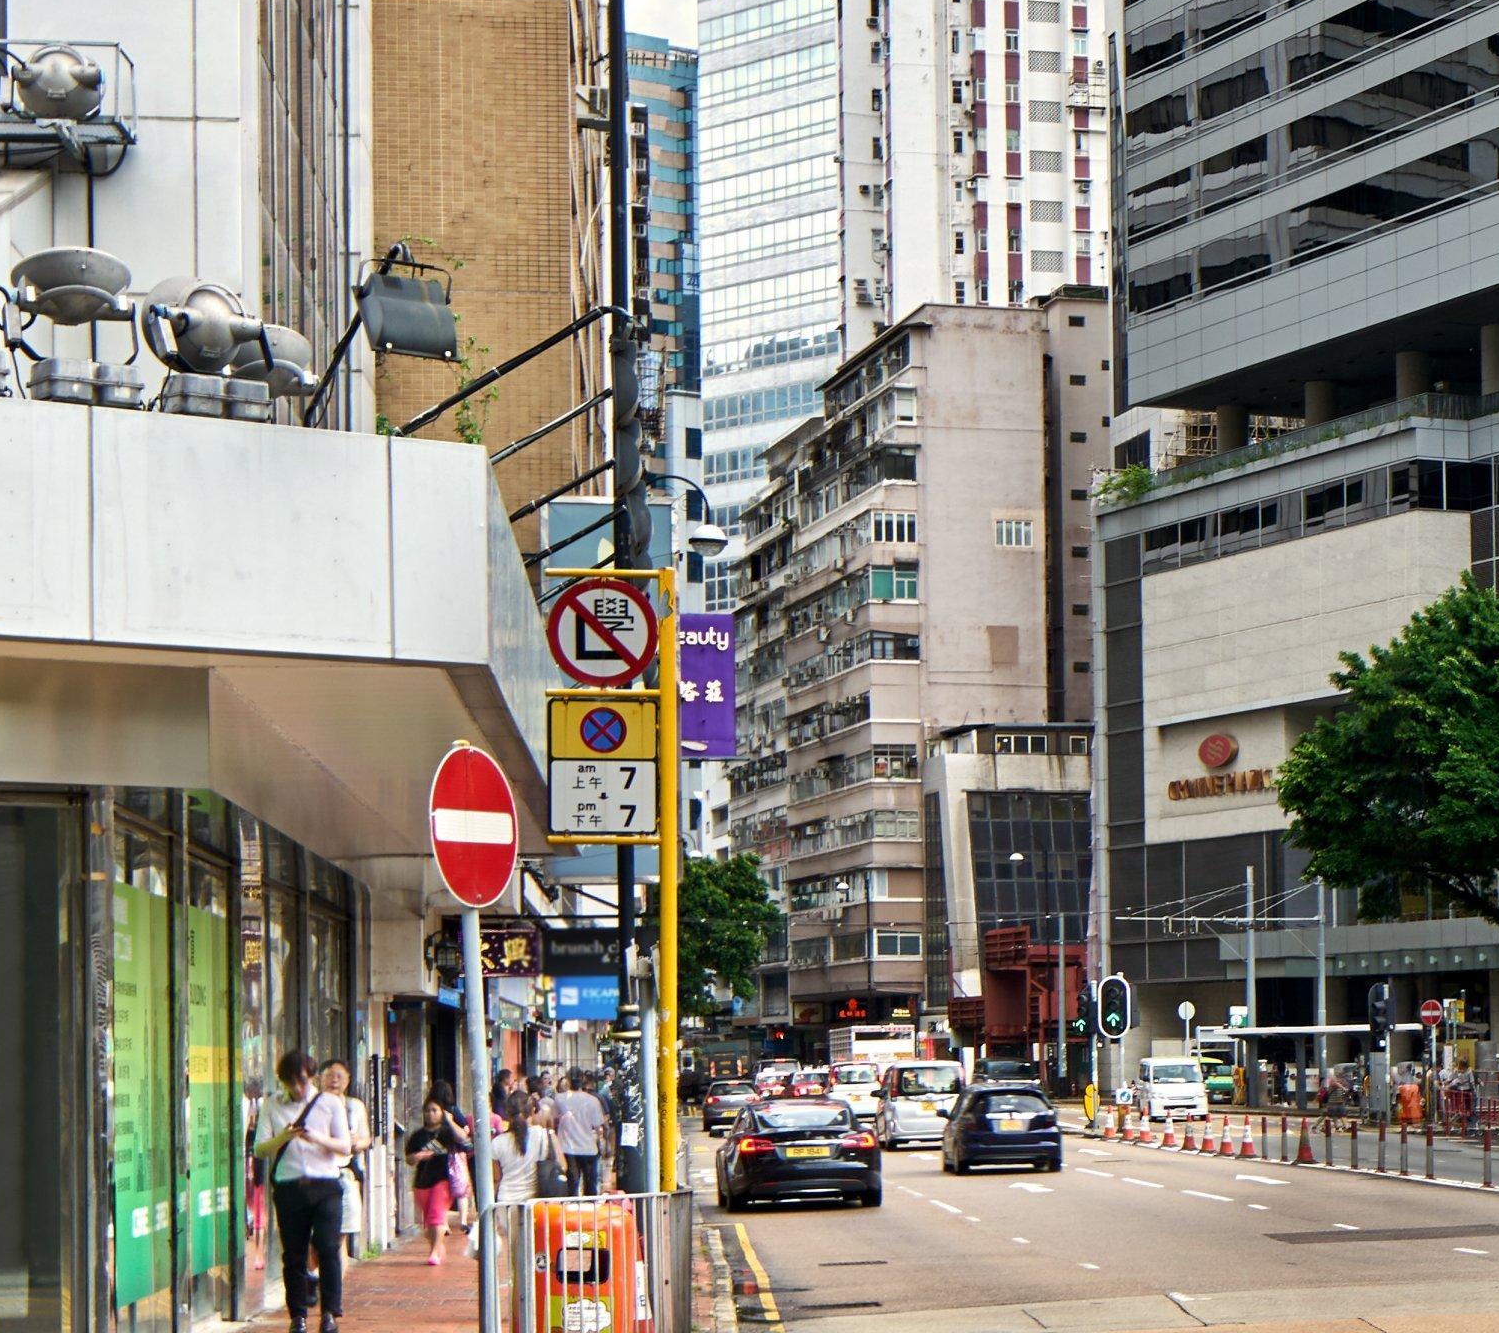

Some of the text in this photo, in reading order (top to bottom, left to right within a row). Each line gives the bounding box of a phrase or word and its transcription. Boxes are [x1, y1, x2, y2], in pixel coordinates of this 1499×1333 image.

[572, 776, 602, 789] 上午
[577, 765, 637, 789] am 7
[572, 814, 602, 827] 下午
[577, 803, 637, 827] pm 7
